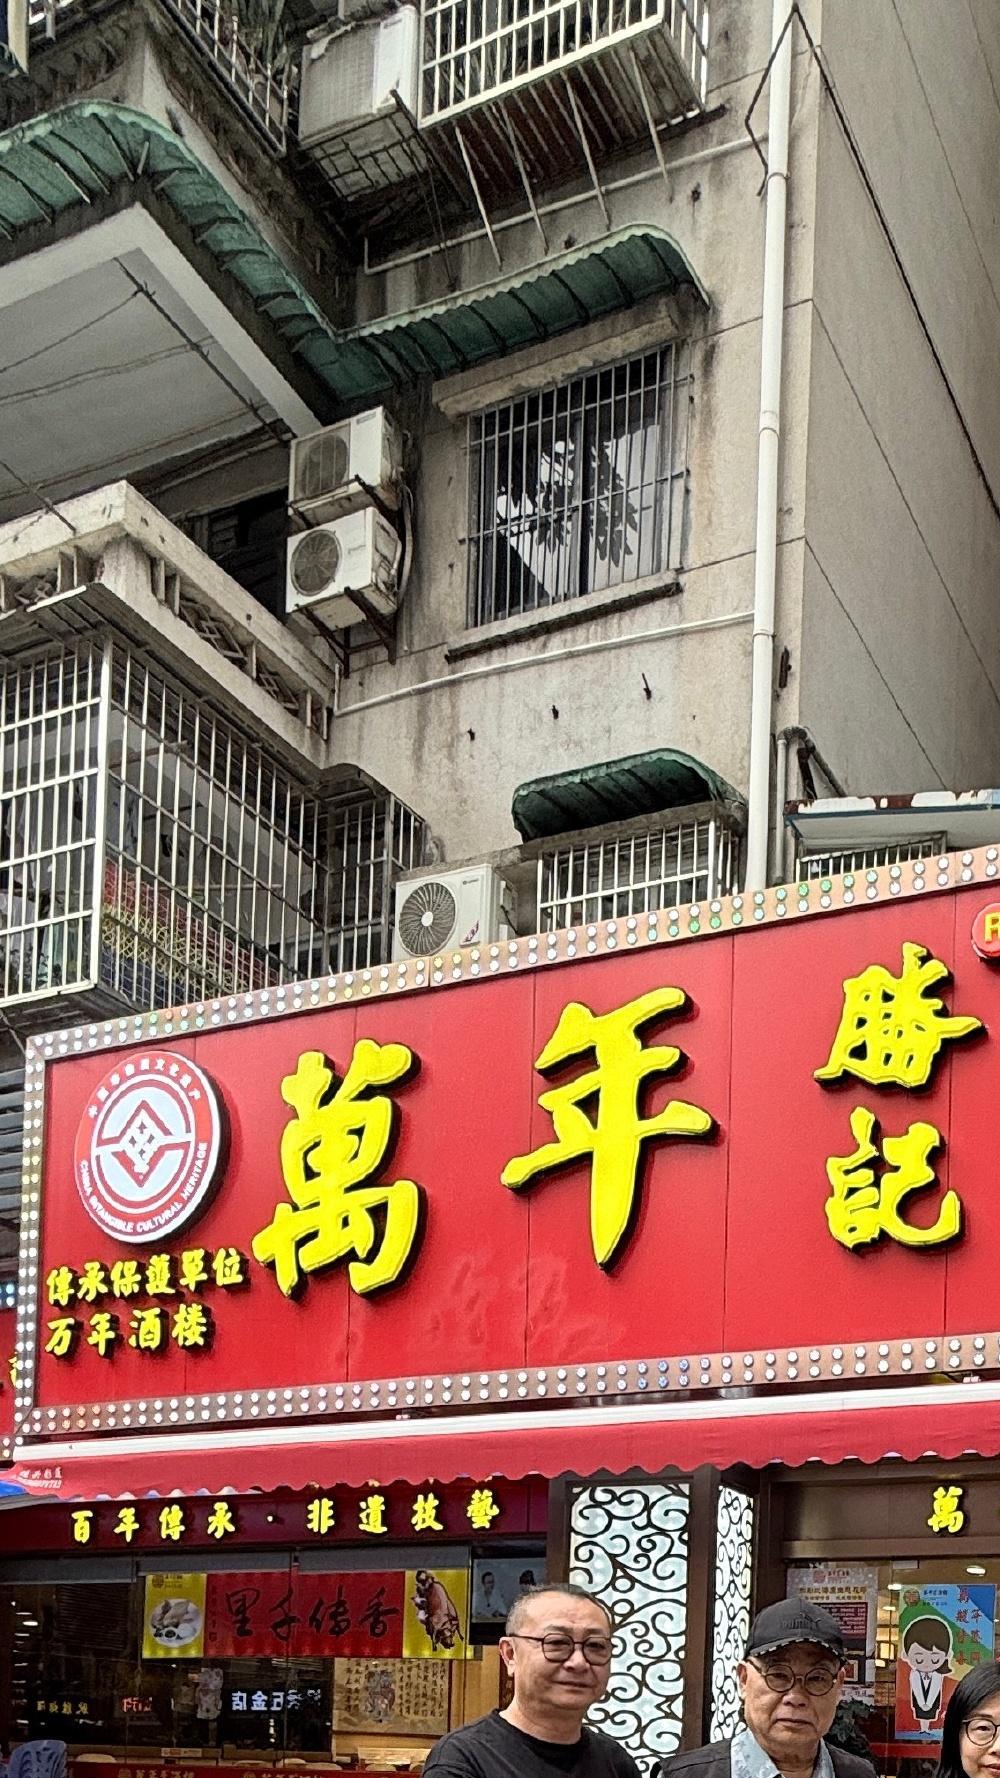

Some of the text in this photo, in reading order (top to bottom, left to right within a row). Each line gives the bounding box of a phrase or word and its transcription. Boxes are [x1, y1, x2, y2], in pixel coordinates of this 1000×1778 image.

[136, 1202, 183, 1233] CULTURAL
[180, 1142, 208, 1201] HERITAGE
[45, 1303, 207, 1356] 万年酒楼
